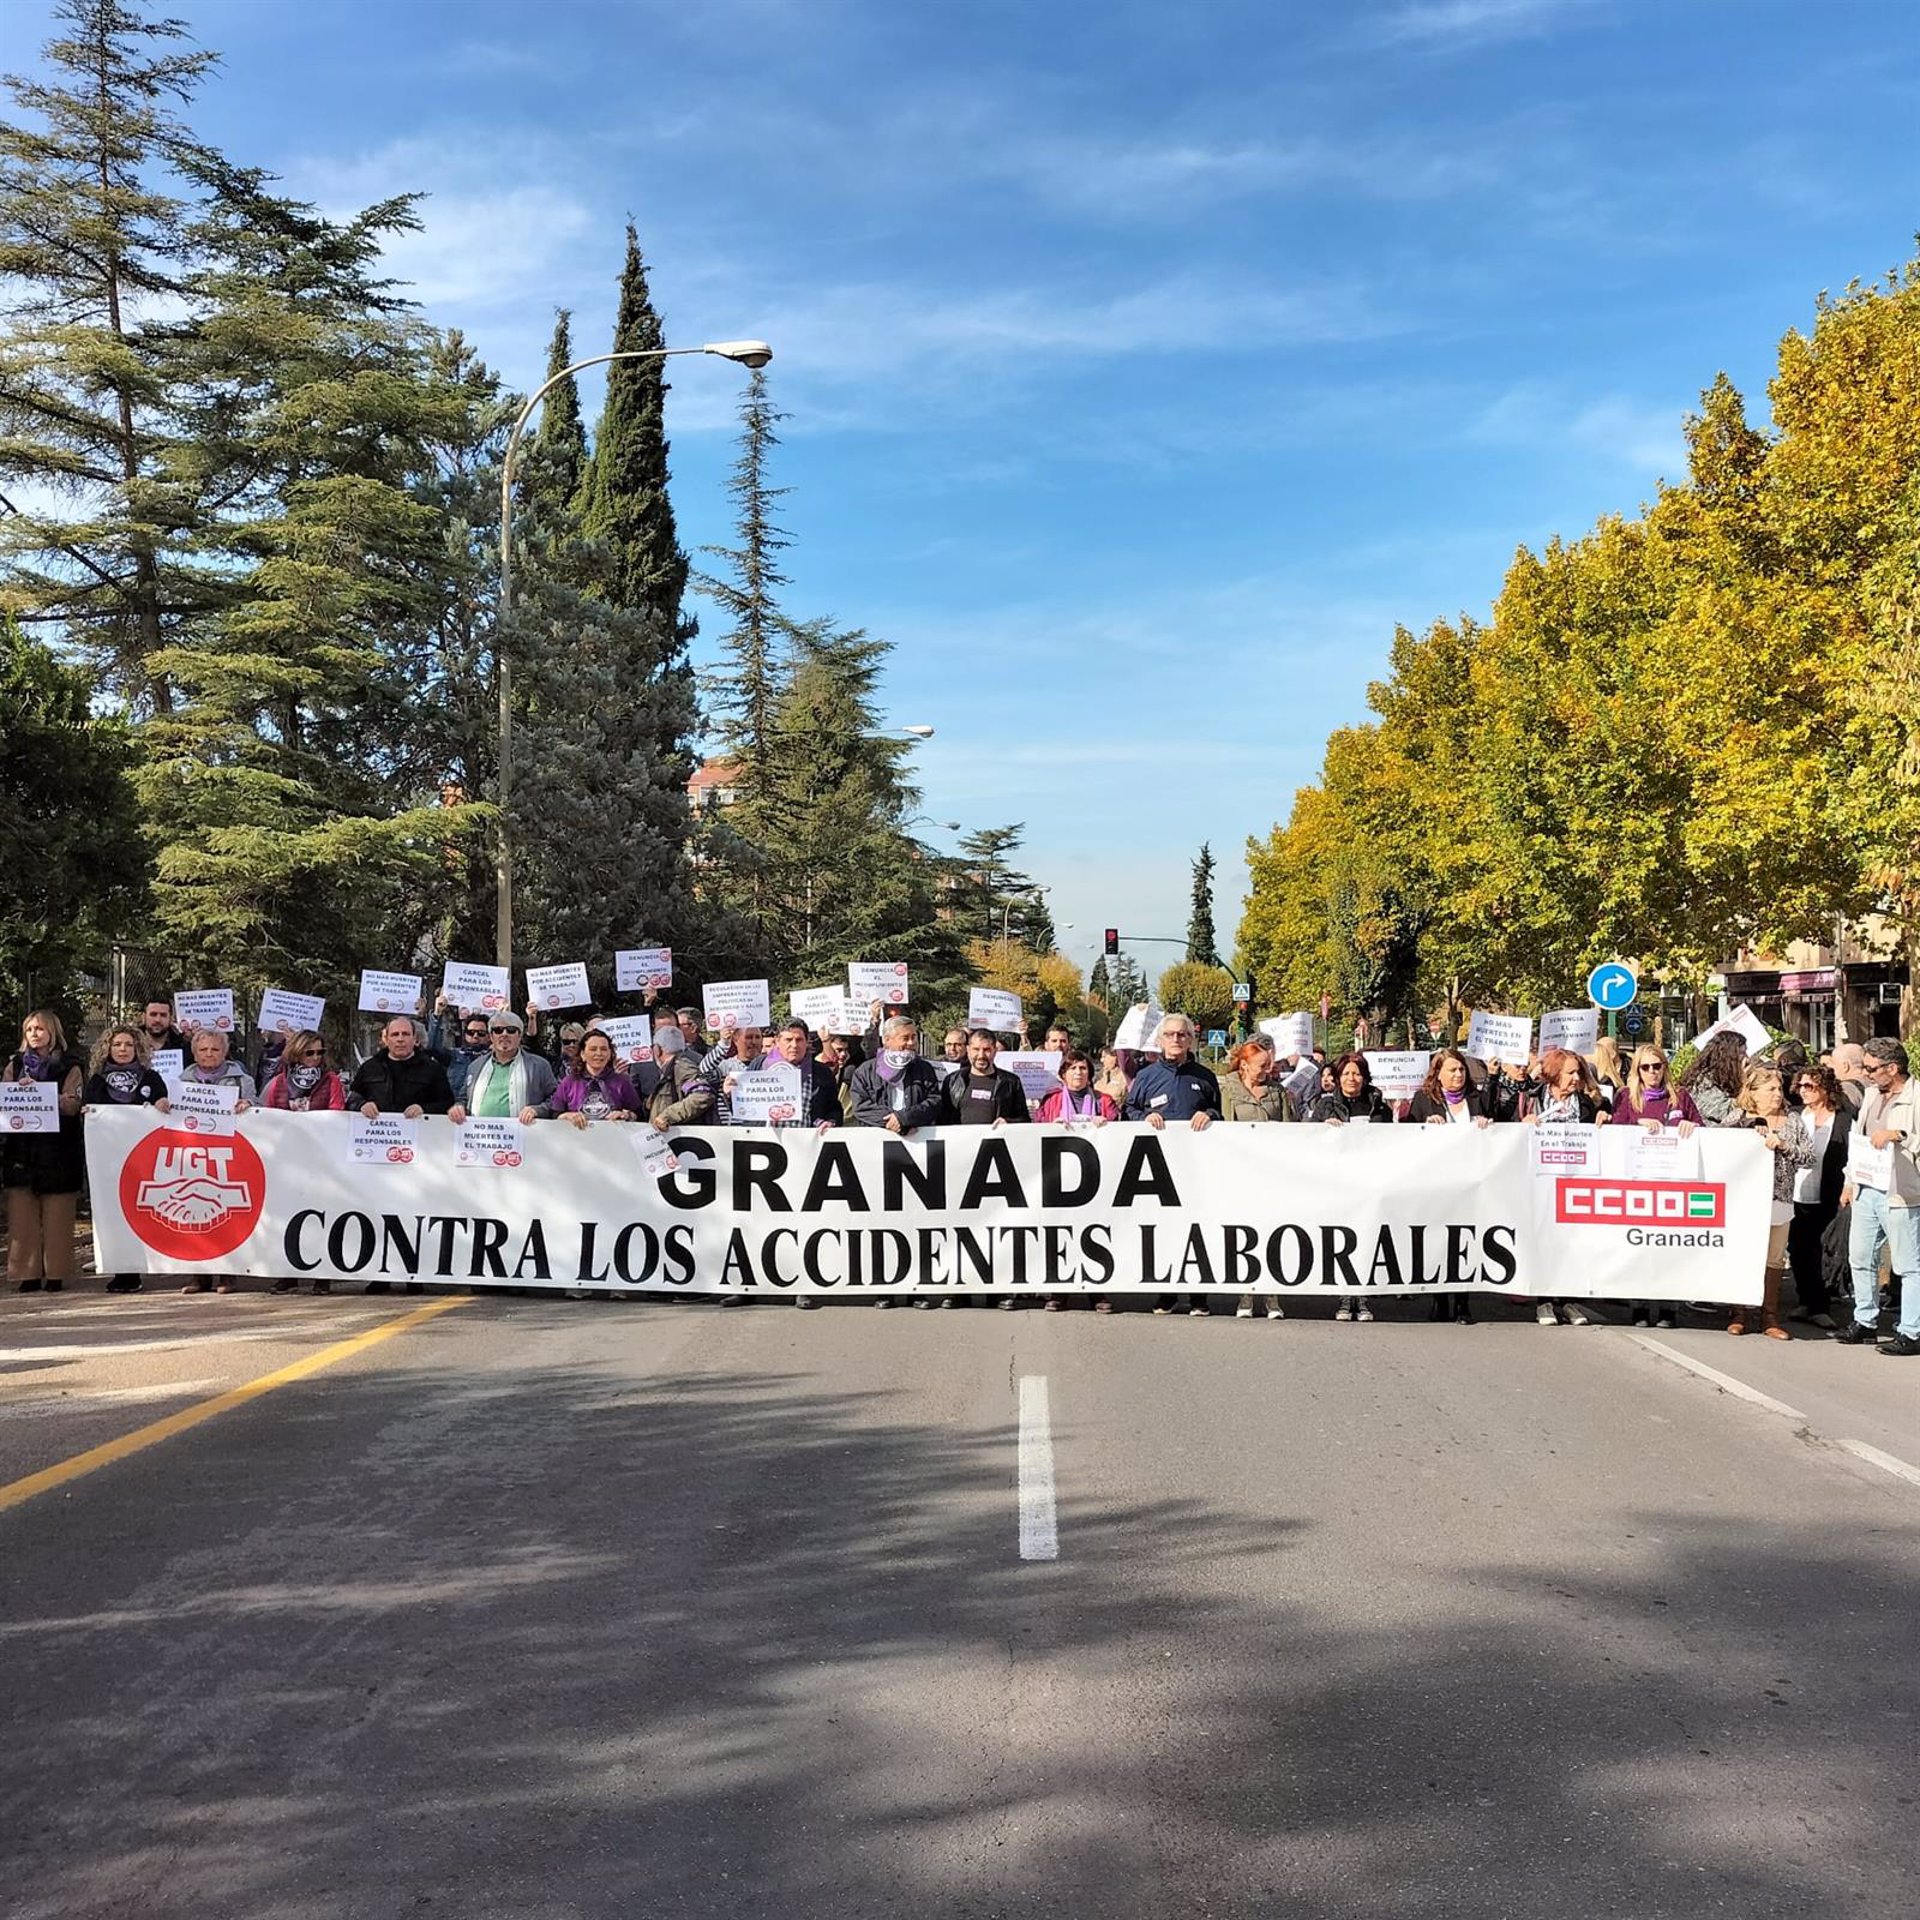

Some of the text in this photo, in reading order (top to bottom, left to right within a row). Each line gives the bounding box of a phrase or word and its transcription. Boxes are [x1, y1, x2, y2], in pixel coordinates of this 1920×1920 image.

[170, 1103, 231, 1116] RESPONSABLES
[476, 1142, 513, 1150] TRABAJO
[1560, 1140, 1587, 1149] Trabajo
[153, 1147, 234, 1183] UGT
[657, 1136, 1182, 1212] GRANADA
[1565, 1187, 1685, 1218] CCOO
[284, 1209, 1516, 1289] CONTRA LOS ACCIDENTES LABORALES
[1626, 1228, 1725, 1248] Granada
